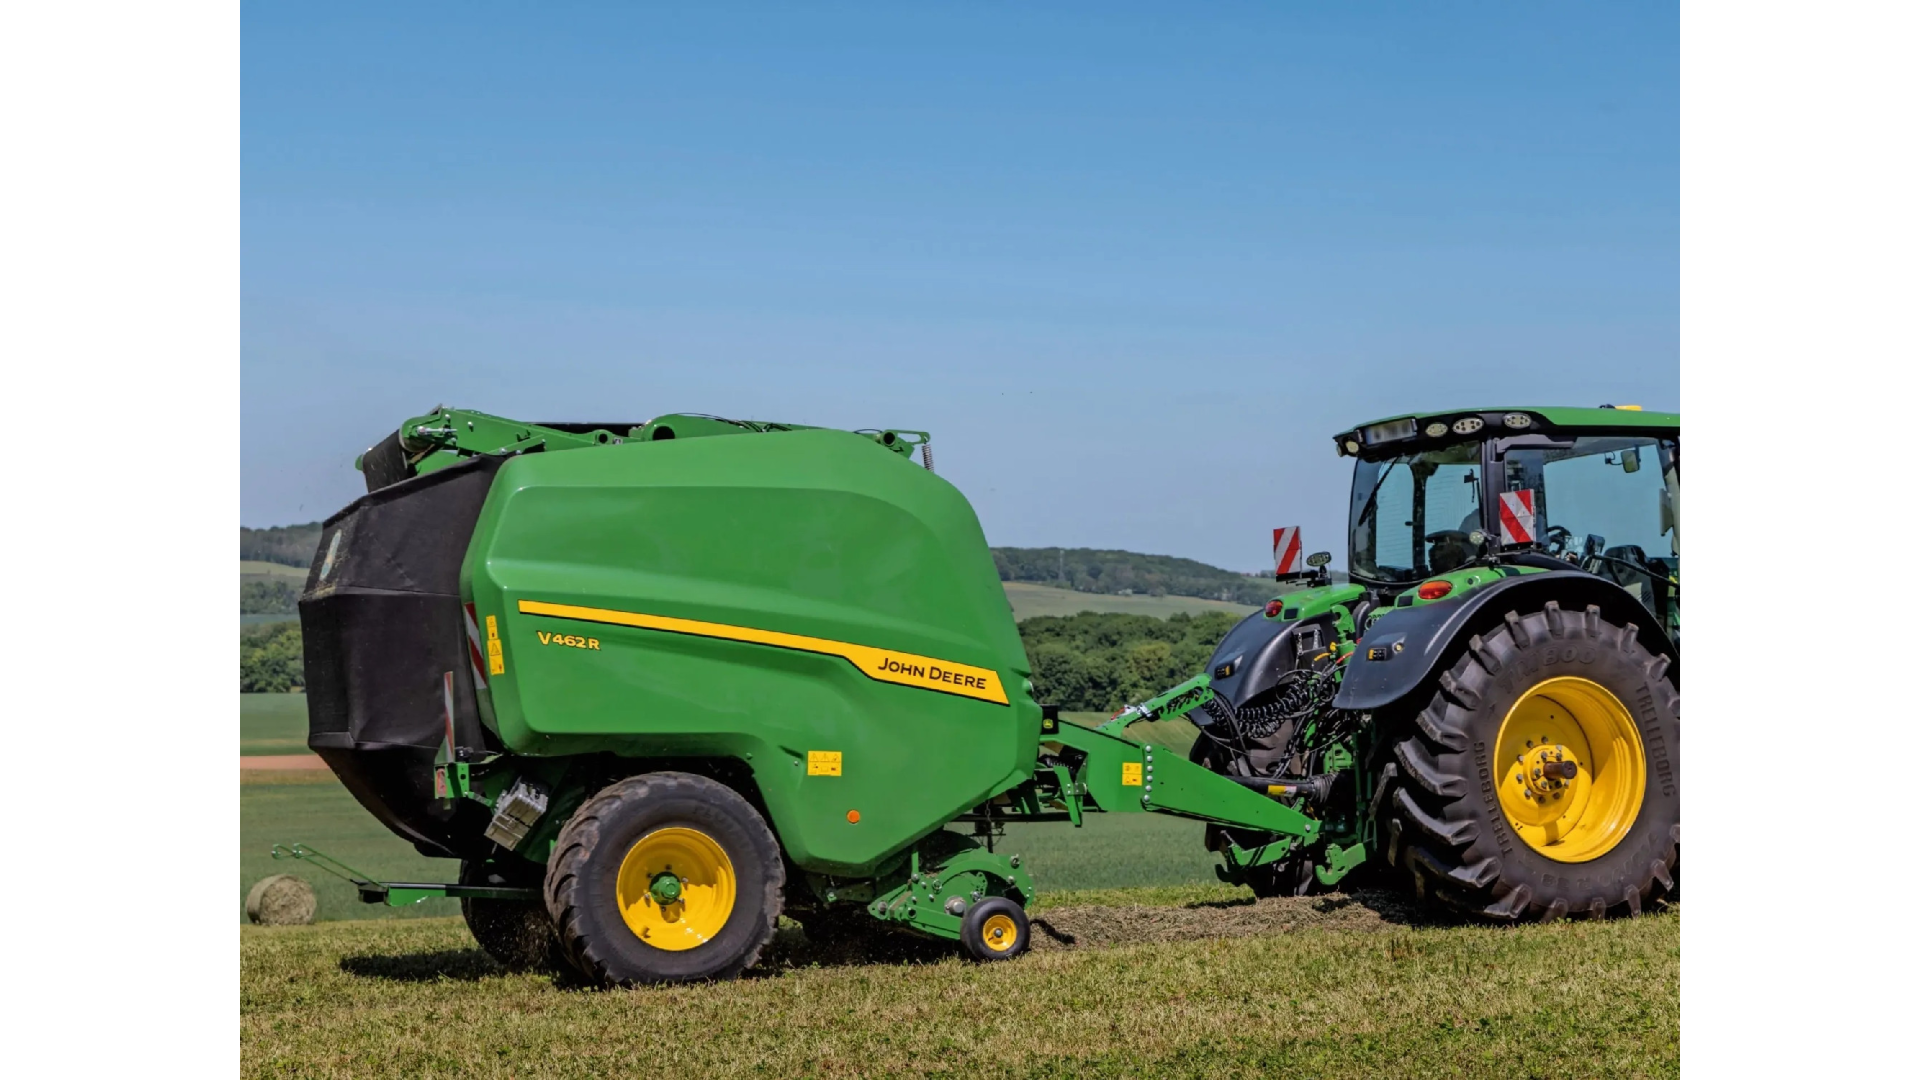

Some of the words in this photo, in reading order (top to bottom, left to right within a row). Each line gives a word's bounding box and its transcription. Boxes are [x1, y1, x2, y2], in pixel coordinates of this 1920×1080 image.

[536, 630, 601, 651] V462R
[878, 657, 925, 678] JOHN
[929, 666, 986, 689] DEERE
[1635, 681, 1677, 797] TRELLEBORG
[1473, 741, 1514, 859] TRELLEBORG
